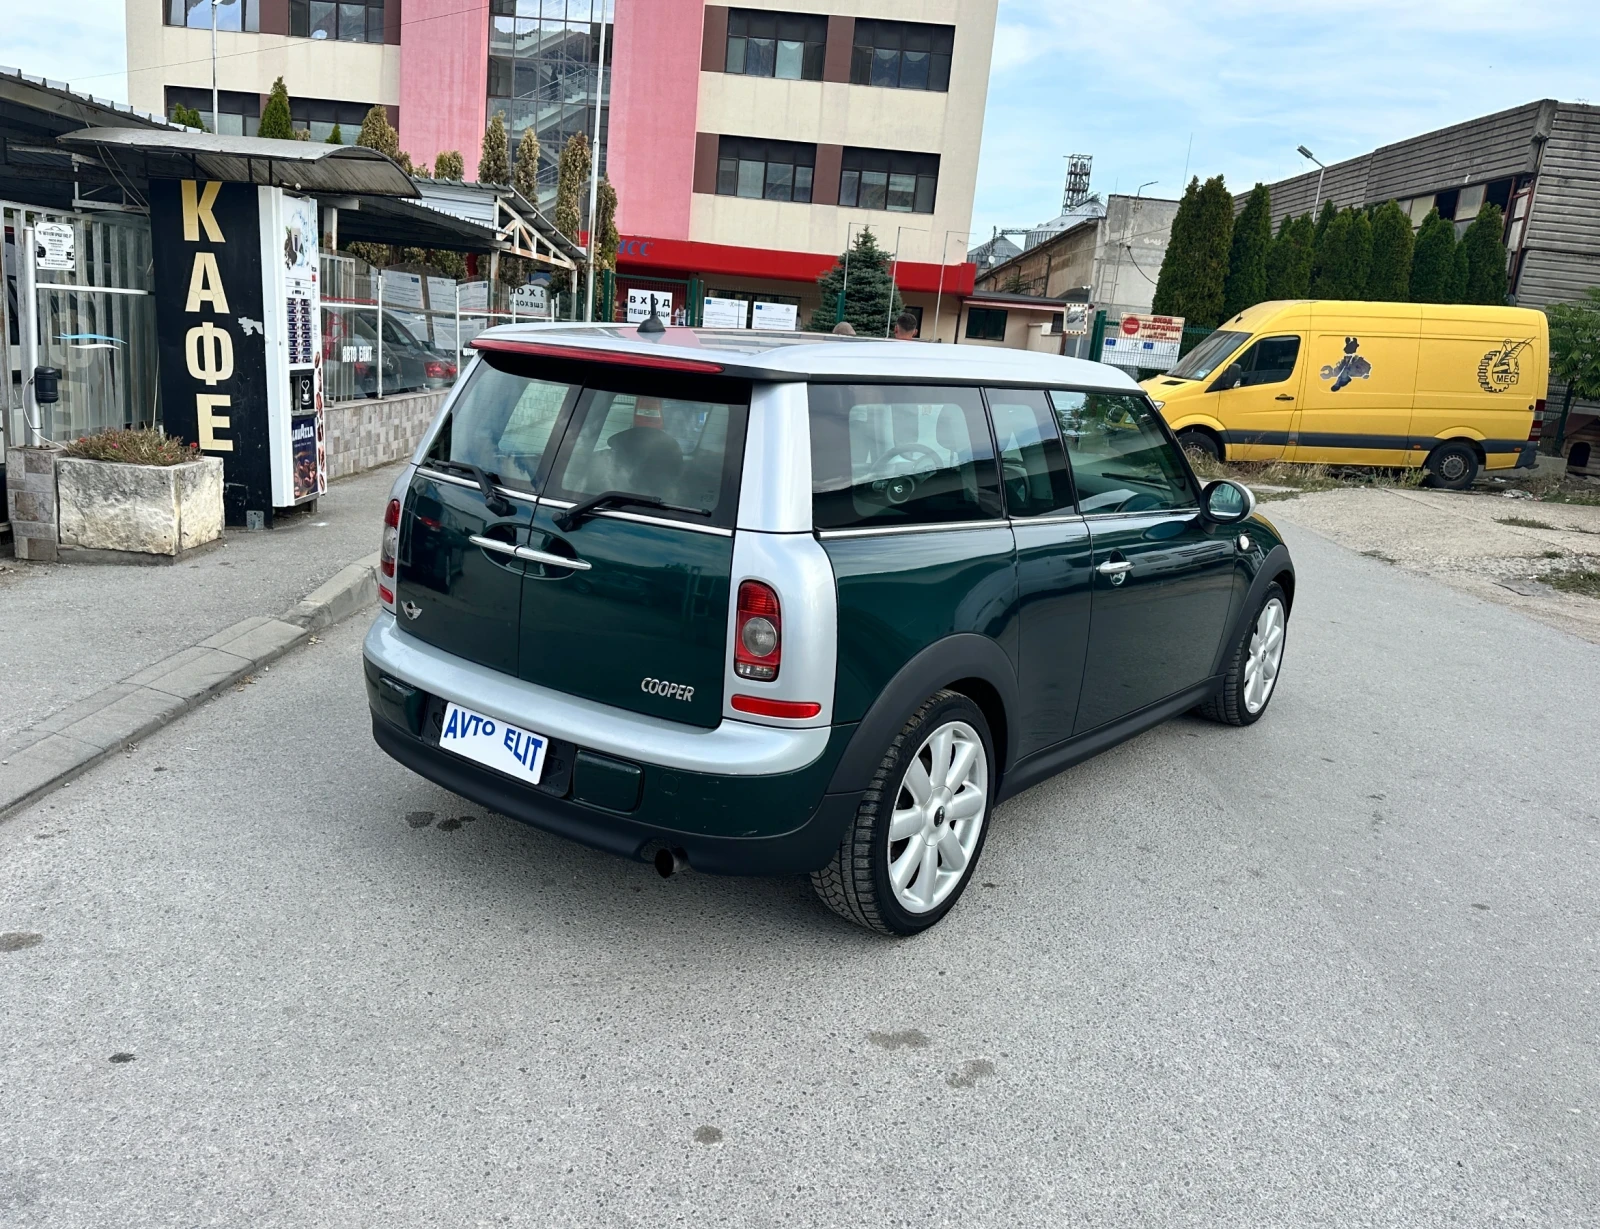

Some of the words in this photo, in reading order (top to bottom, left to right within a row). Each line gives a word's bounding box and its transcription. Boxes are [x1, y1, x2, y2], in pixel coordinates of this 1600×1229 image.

[181, 180, 234, 451] КАФЕ
[628, 308, 670, 318] ПЕШЕХДЦИ
[1496, 374, 1516, 383] MEC
[641, 677, 695, 702] COOPER
[443, 708, 496, 739] AVTO
[503, 728, 543, 772] ELIT
